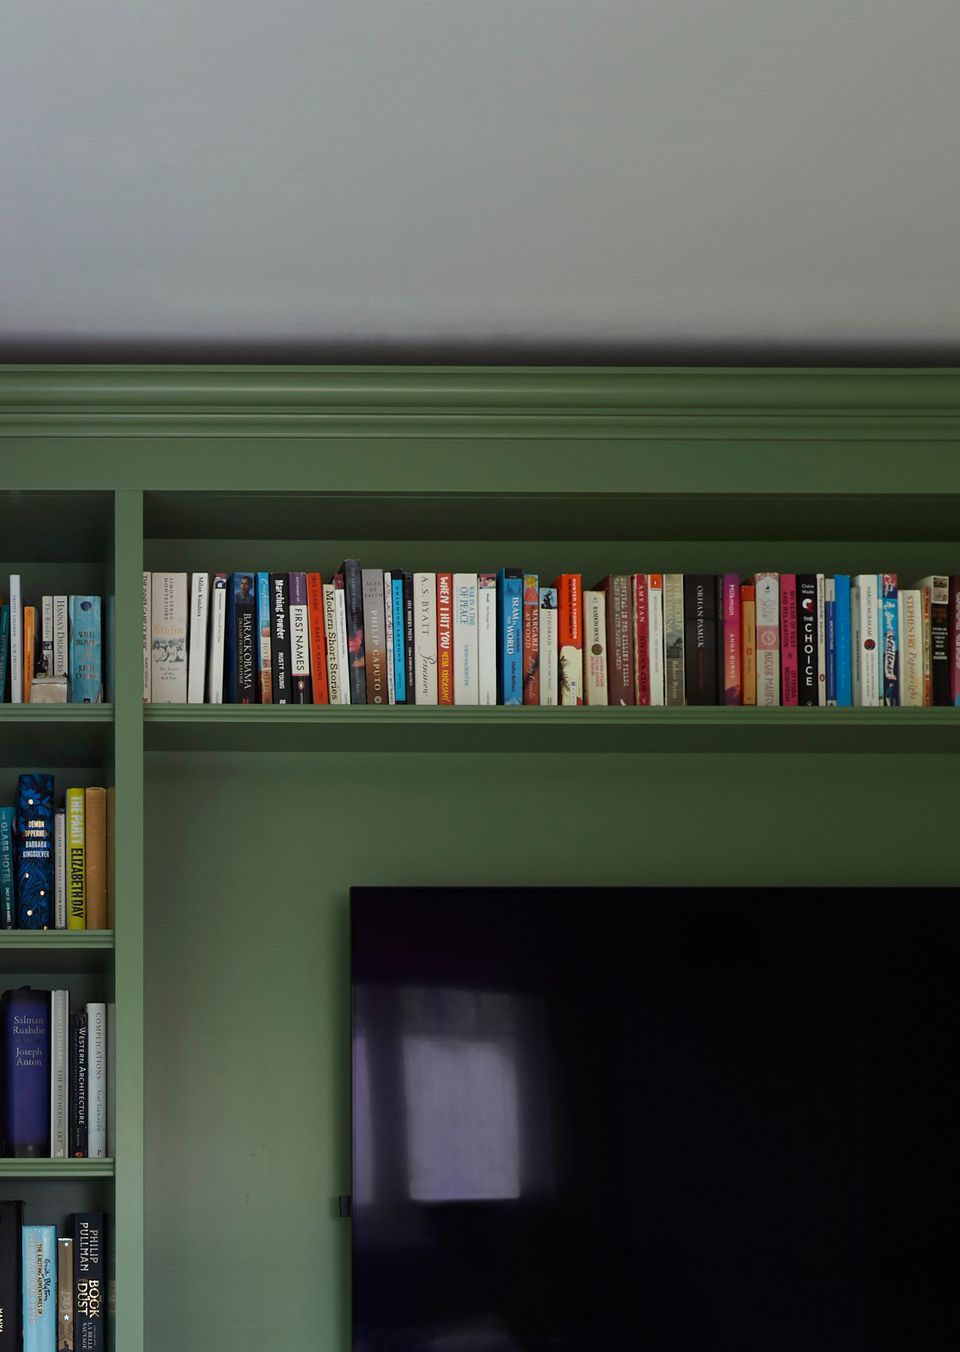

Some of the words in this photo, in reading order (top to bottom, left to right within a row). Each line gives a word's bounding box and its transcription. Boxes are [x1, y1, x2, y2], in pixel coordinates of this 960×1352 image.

[275, 580, 285, 613] Marching
[440, 577, 449, 604] WHEN
[697, 585, 705, 616] ORHAN
[295, 609, 303, 632] FIRST
[326, 591, 334, 630] Modern
[460, 601, 468, 625] PEACE
[243, 613, 253, 652] BARACK
[276, 614, 286, 640] Powder
[440, 632, 450, 649] YOU
[507, 626, 516, 655] WORLD
[697, 618, 705, 648] PAMUK
[56, 632, 65, 673] DAUGHTERS
[296, 635, 304, 671] NAMES
[329, 632, 337, 661] Short
[804, 623, 815, 687] CHOICE
[243, 653, 252, 690] OBAMA
[330, 663, 339, 701] Stories
[373, 650, 381, 692] CAPUTO
[71, 795, 82, 813] THE
[1, 822, 9, 852] GLASS
[71, 815, 83, 845] PARTY
[2, 854, 11, 884] HOTEL
[71, 848, 83, 897] ELIZABETH
[71, 899, 84, 919] DAY
[13, 1016, 44, 1025] Salman
[13, 1026, 46, 1035] Rushdie
[16, 1047, 43, 1058] Joseph
[78, 1027, 87, 1064] WESTERN
[16, 1058, 42, 1067] Anton
[78, 1066, 87, 1125] ARCHITECTURE
[80, 1221, 90, 1272] PULLMAN
[90, 1229, 99, 1265] PHILIP
[77, 1283, 89, 1316] DUST
[88, 1279, 100, 1319] BOOK
